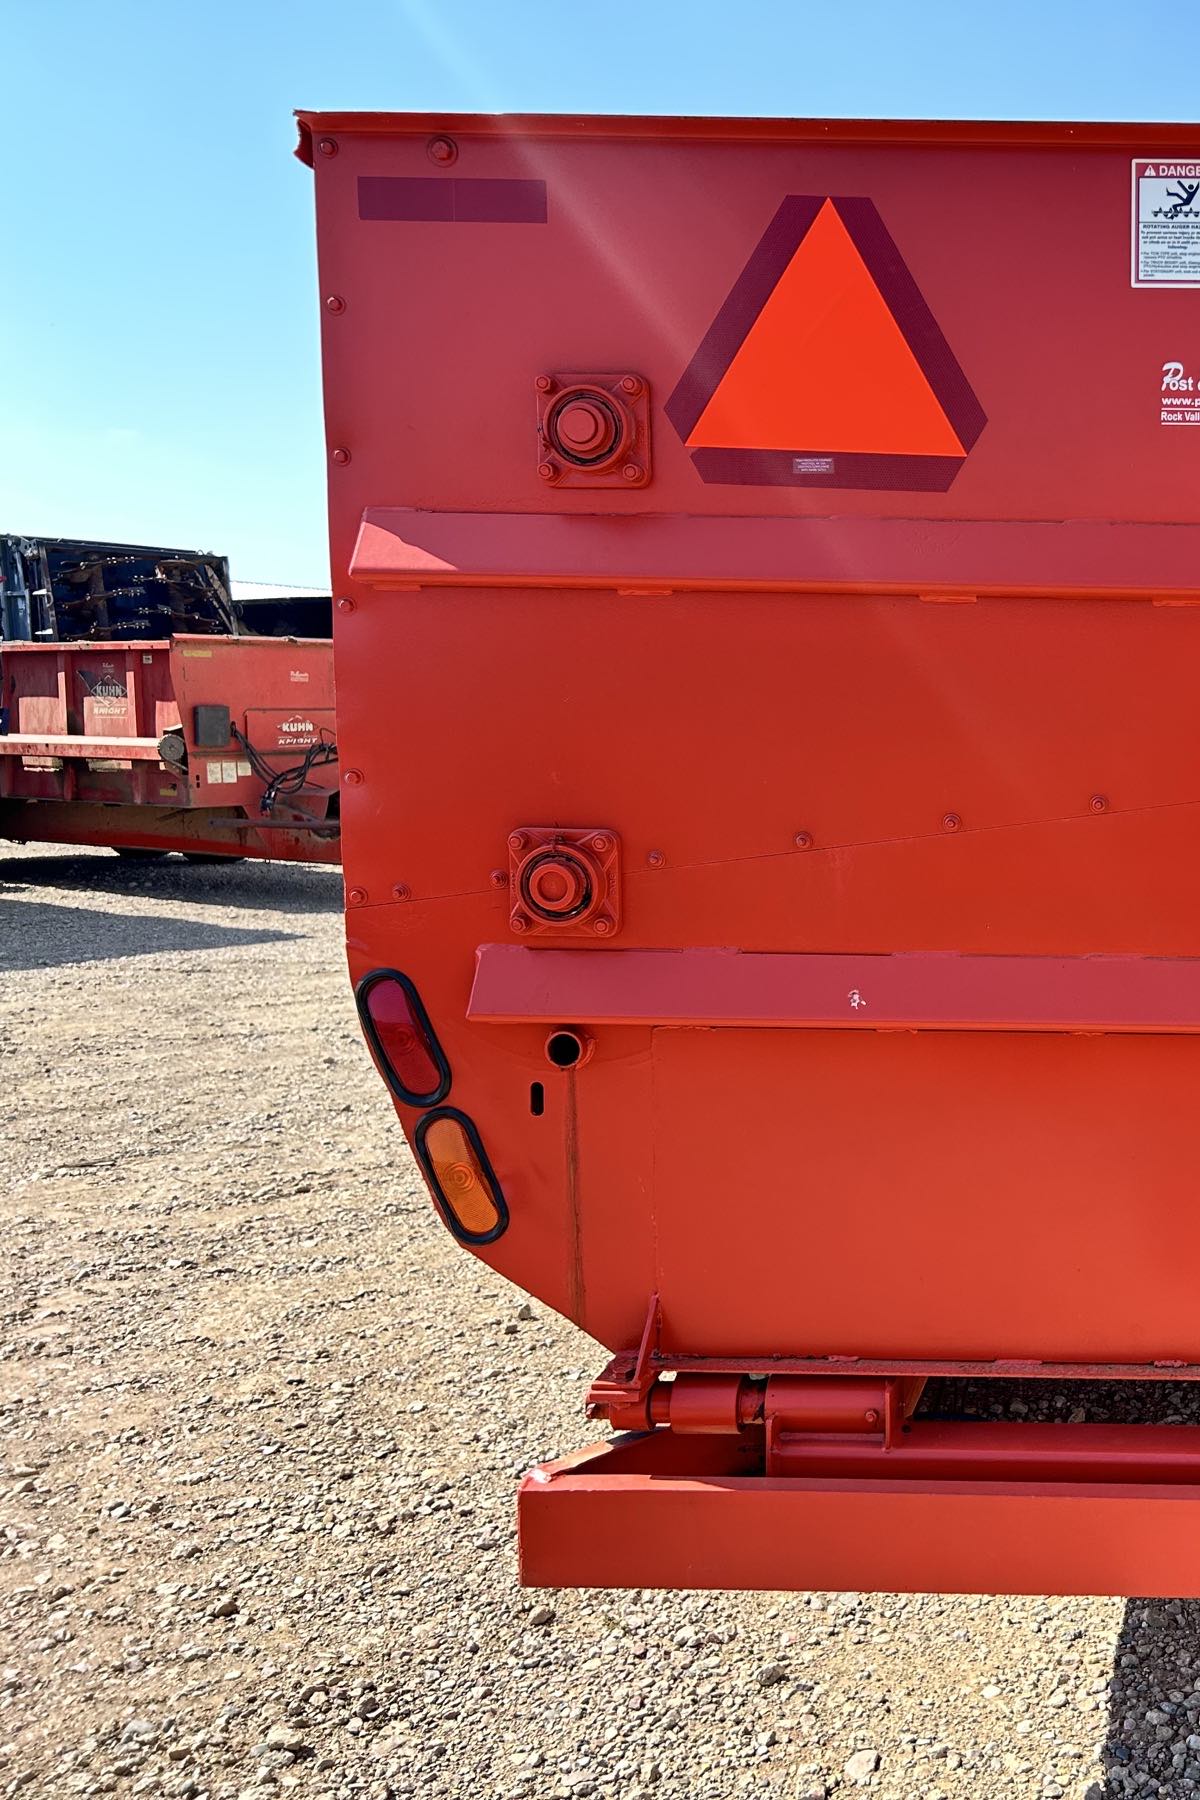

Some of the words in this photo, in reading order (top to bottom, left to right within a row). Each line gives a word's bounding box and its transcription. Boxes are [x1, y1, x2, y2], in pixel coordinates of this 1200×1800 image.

[1161, 361, 1194, 391] Post
[1161, 412, 1182, 421] Rock
[96, 685, 122, 697] KUHN
[282, 722, 314, 732] KUHN
[278, 737, 318, 745] KNIGHT
